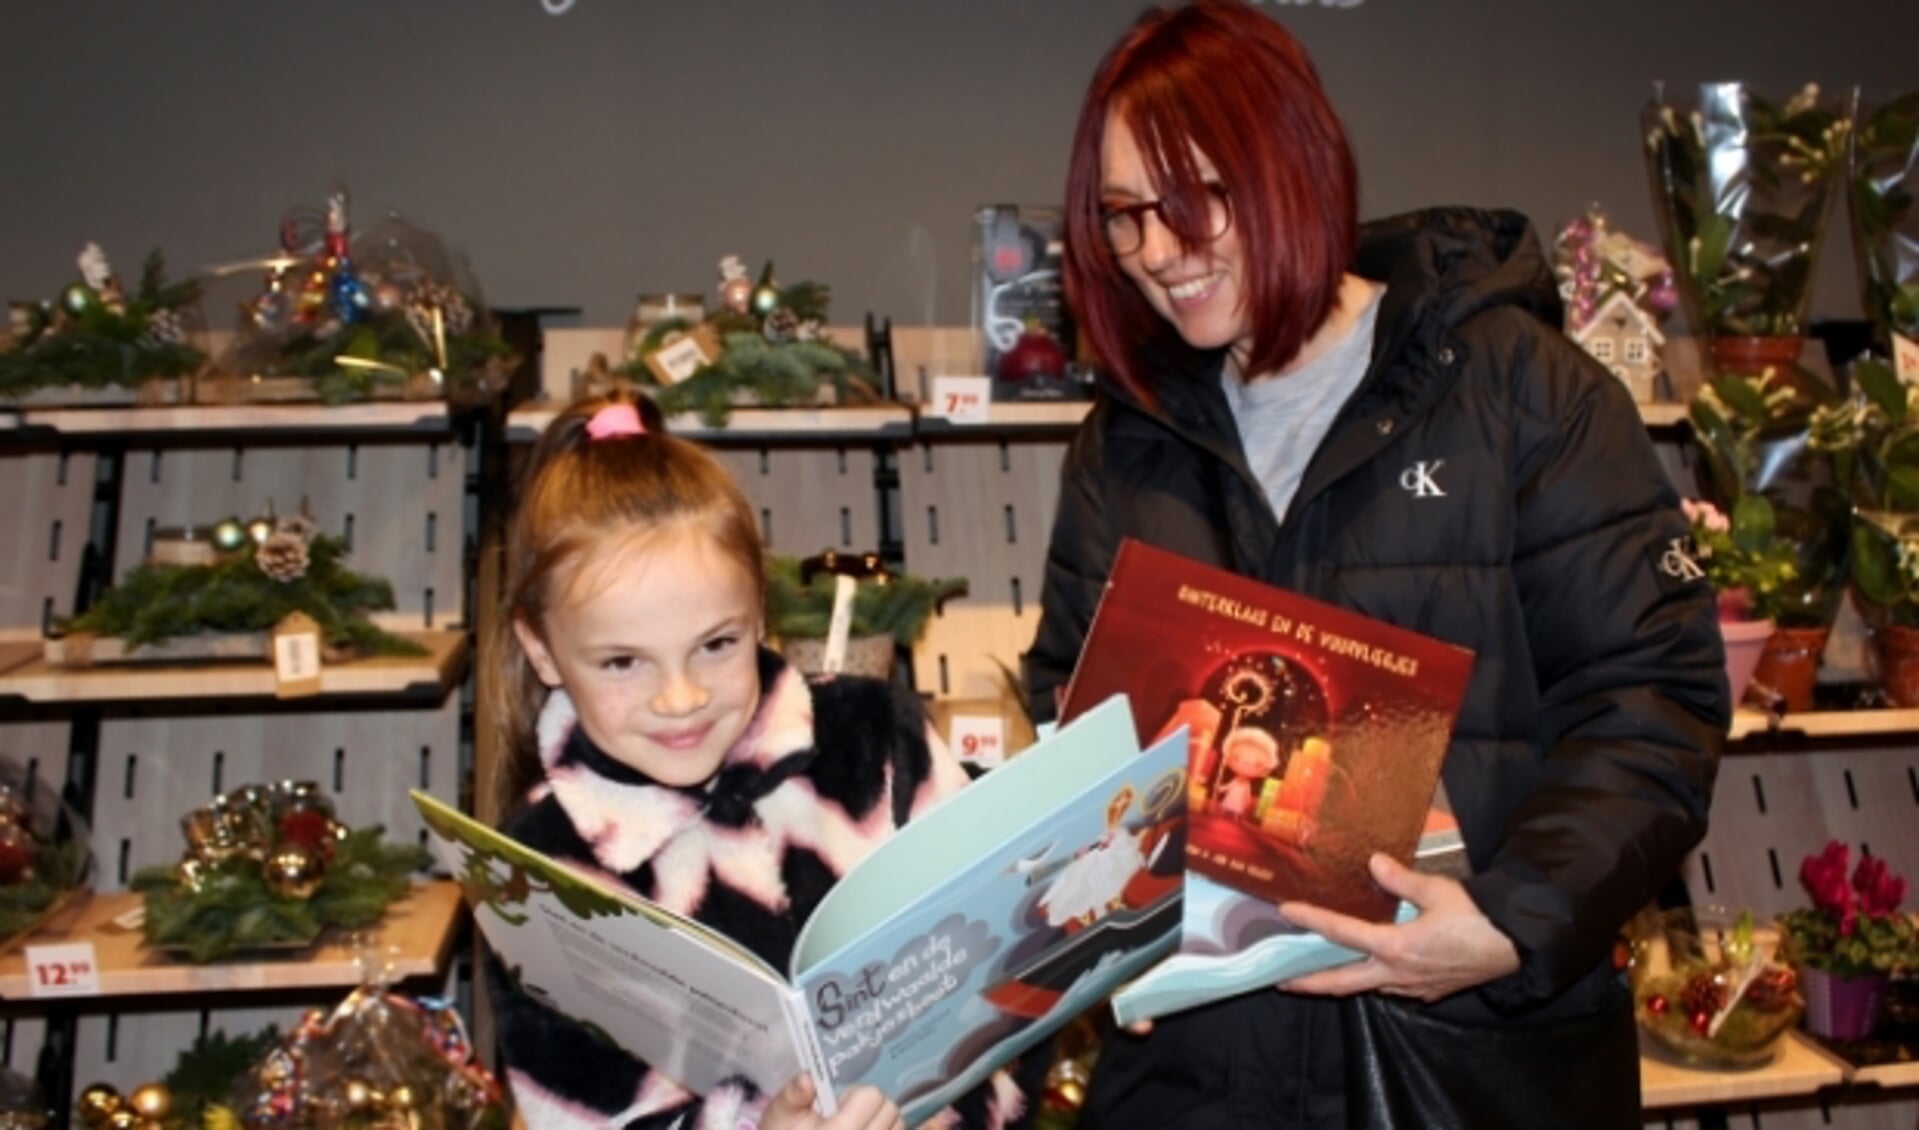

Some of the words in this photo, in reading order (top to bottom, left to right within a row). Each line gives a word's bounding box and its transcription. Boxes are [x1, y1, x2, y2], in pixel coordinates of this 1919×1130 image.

[1271, 615, 1292, 635] EN
[816, 964, 886, 1031] Sint
[888, 953, 919, 983] en
